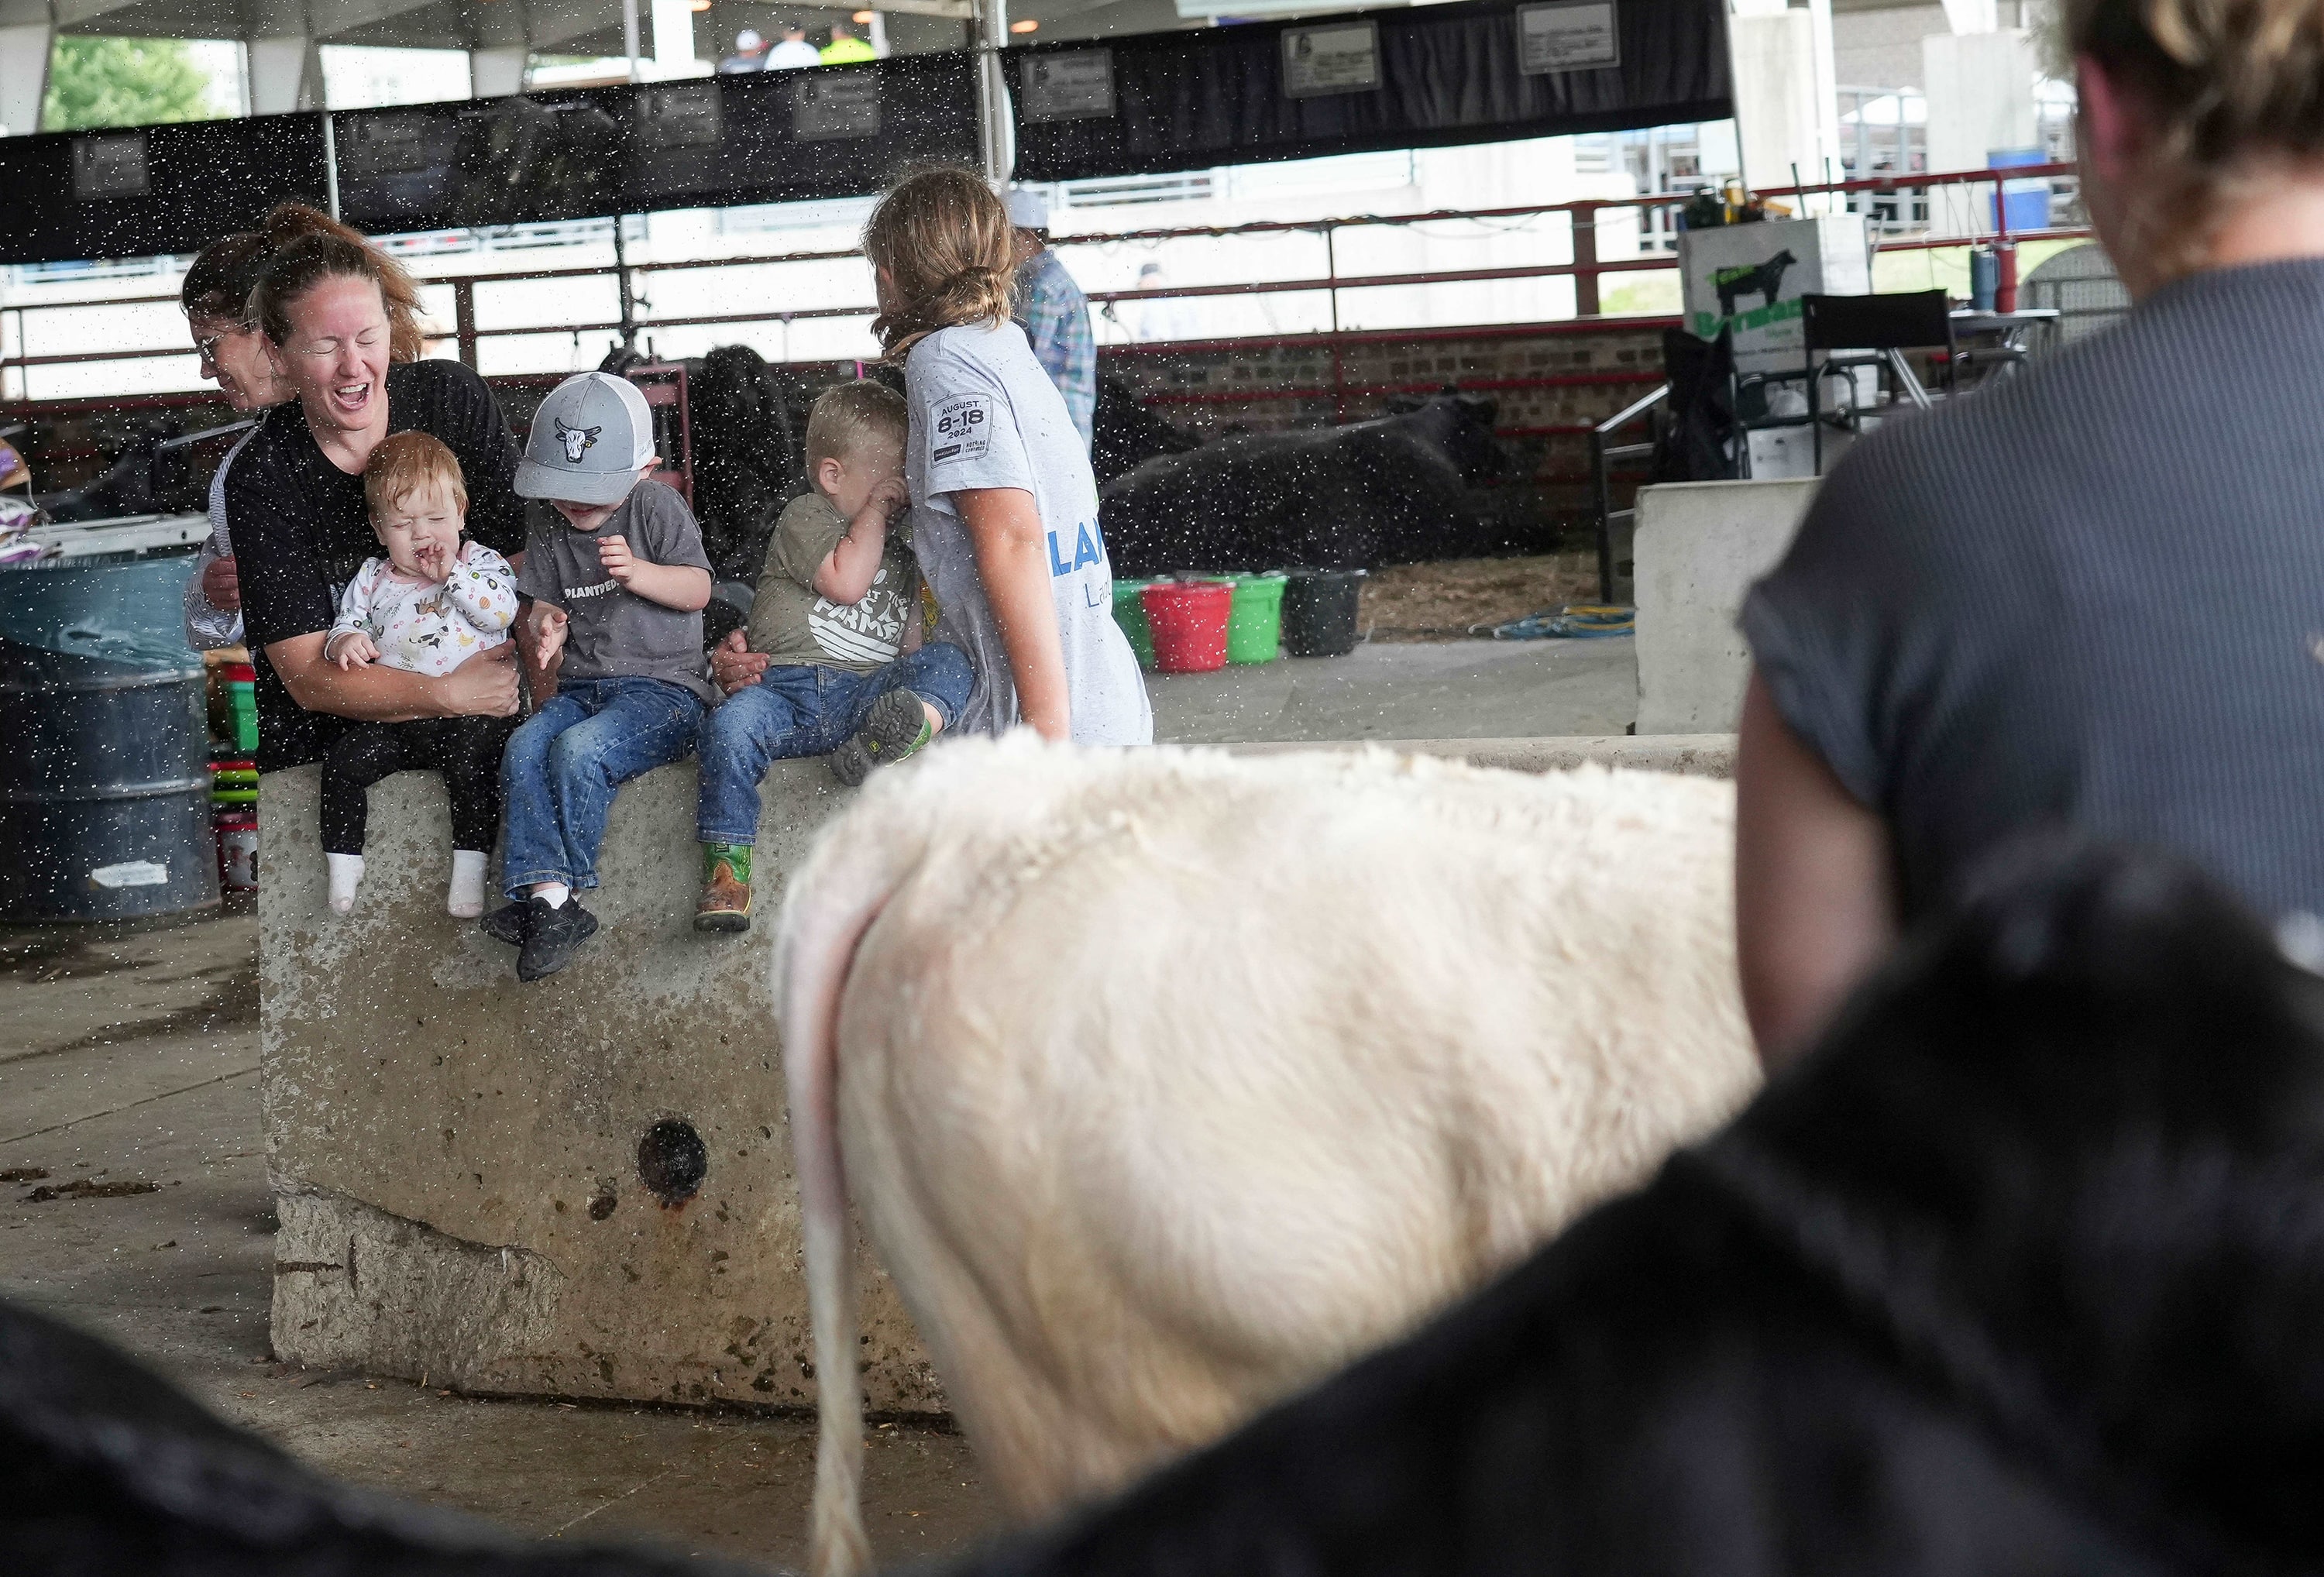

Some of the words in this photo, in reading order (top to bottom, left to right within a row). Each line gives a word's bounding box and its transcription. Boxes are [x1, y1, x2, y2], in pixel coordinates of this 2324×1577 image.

[941, 400, 979, 416] AUGUST
[938, 409, 984, 433] 8-18
[947, 426, 972, 439] 2024
[1047, 517, 1102, 577] LA
[565, 578, 621, 599] PLANTPED
